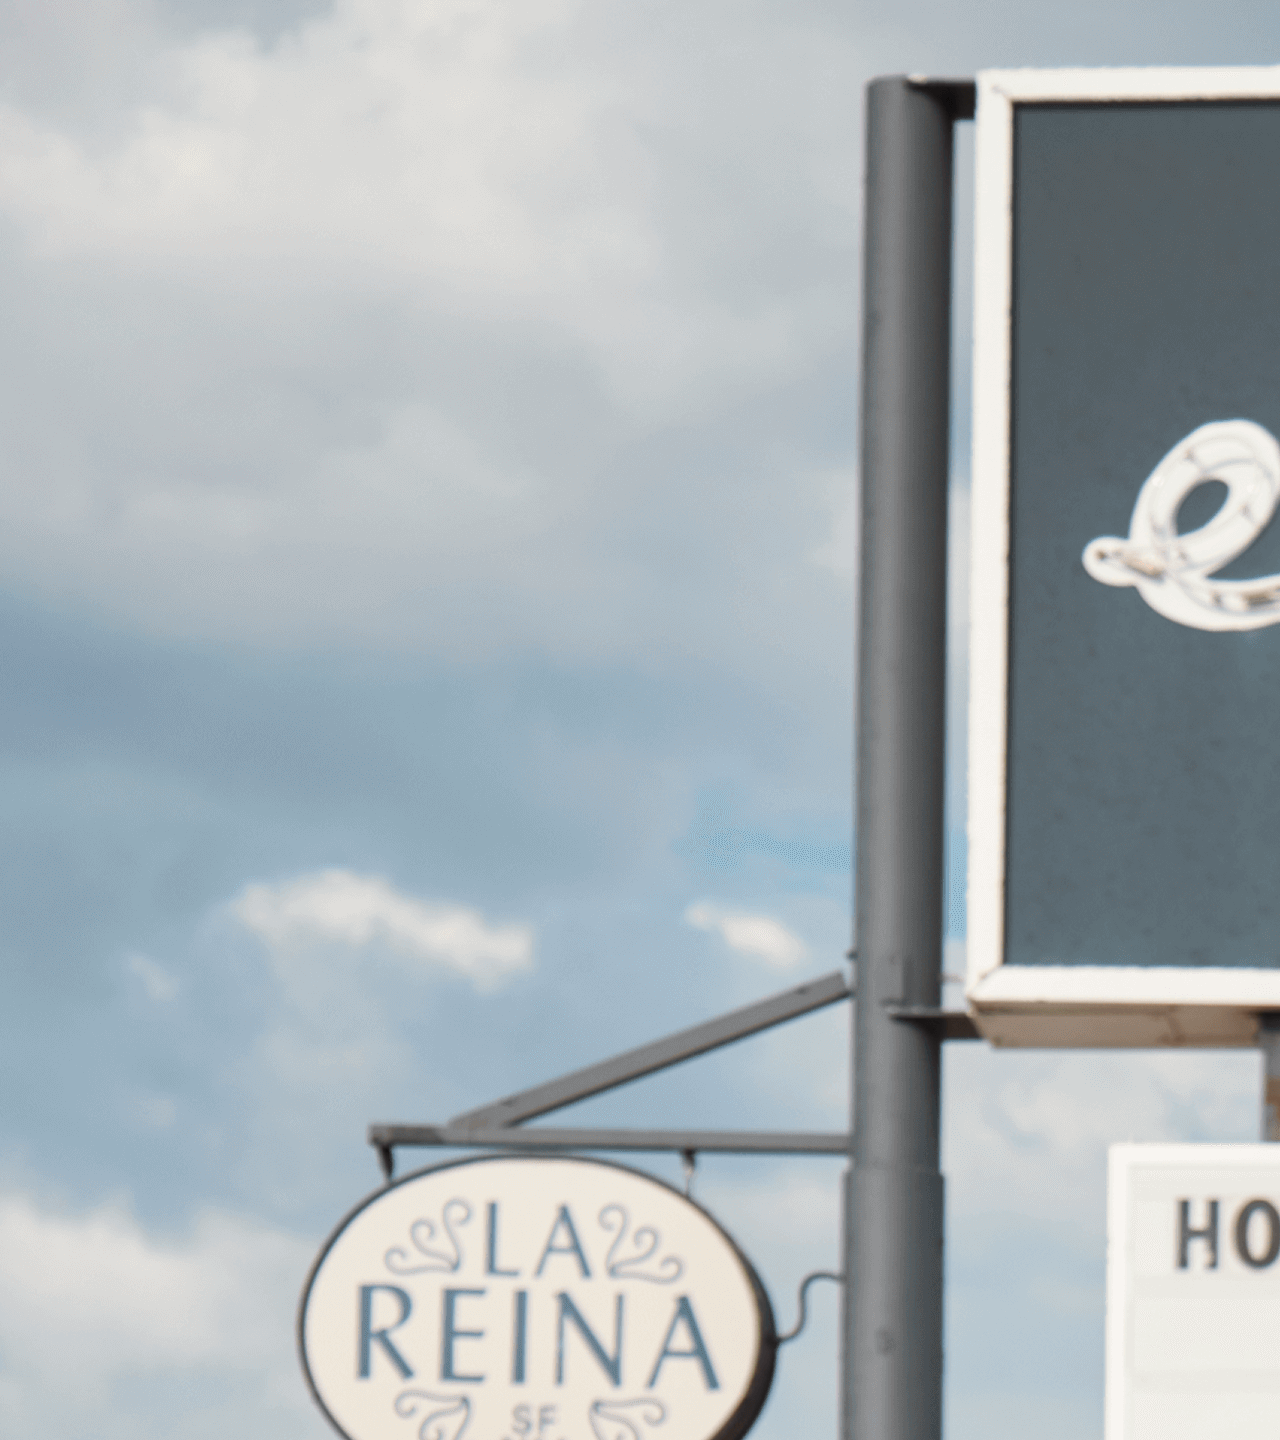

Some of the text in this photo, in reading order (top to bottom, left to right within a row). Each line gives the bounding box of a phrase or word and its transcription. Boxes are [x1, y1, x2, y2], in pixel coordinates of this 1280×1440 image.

[484, 1200, 592, 1280] LA
[356, 1283, 721, 1392] REINA
[512, 1403, 556, 1436] SF
